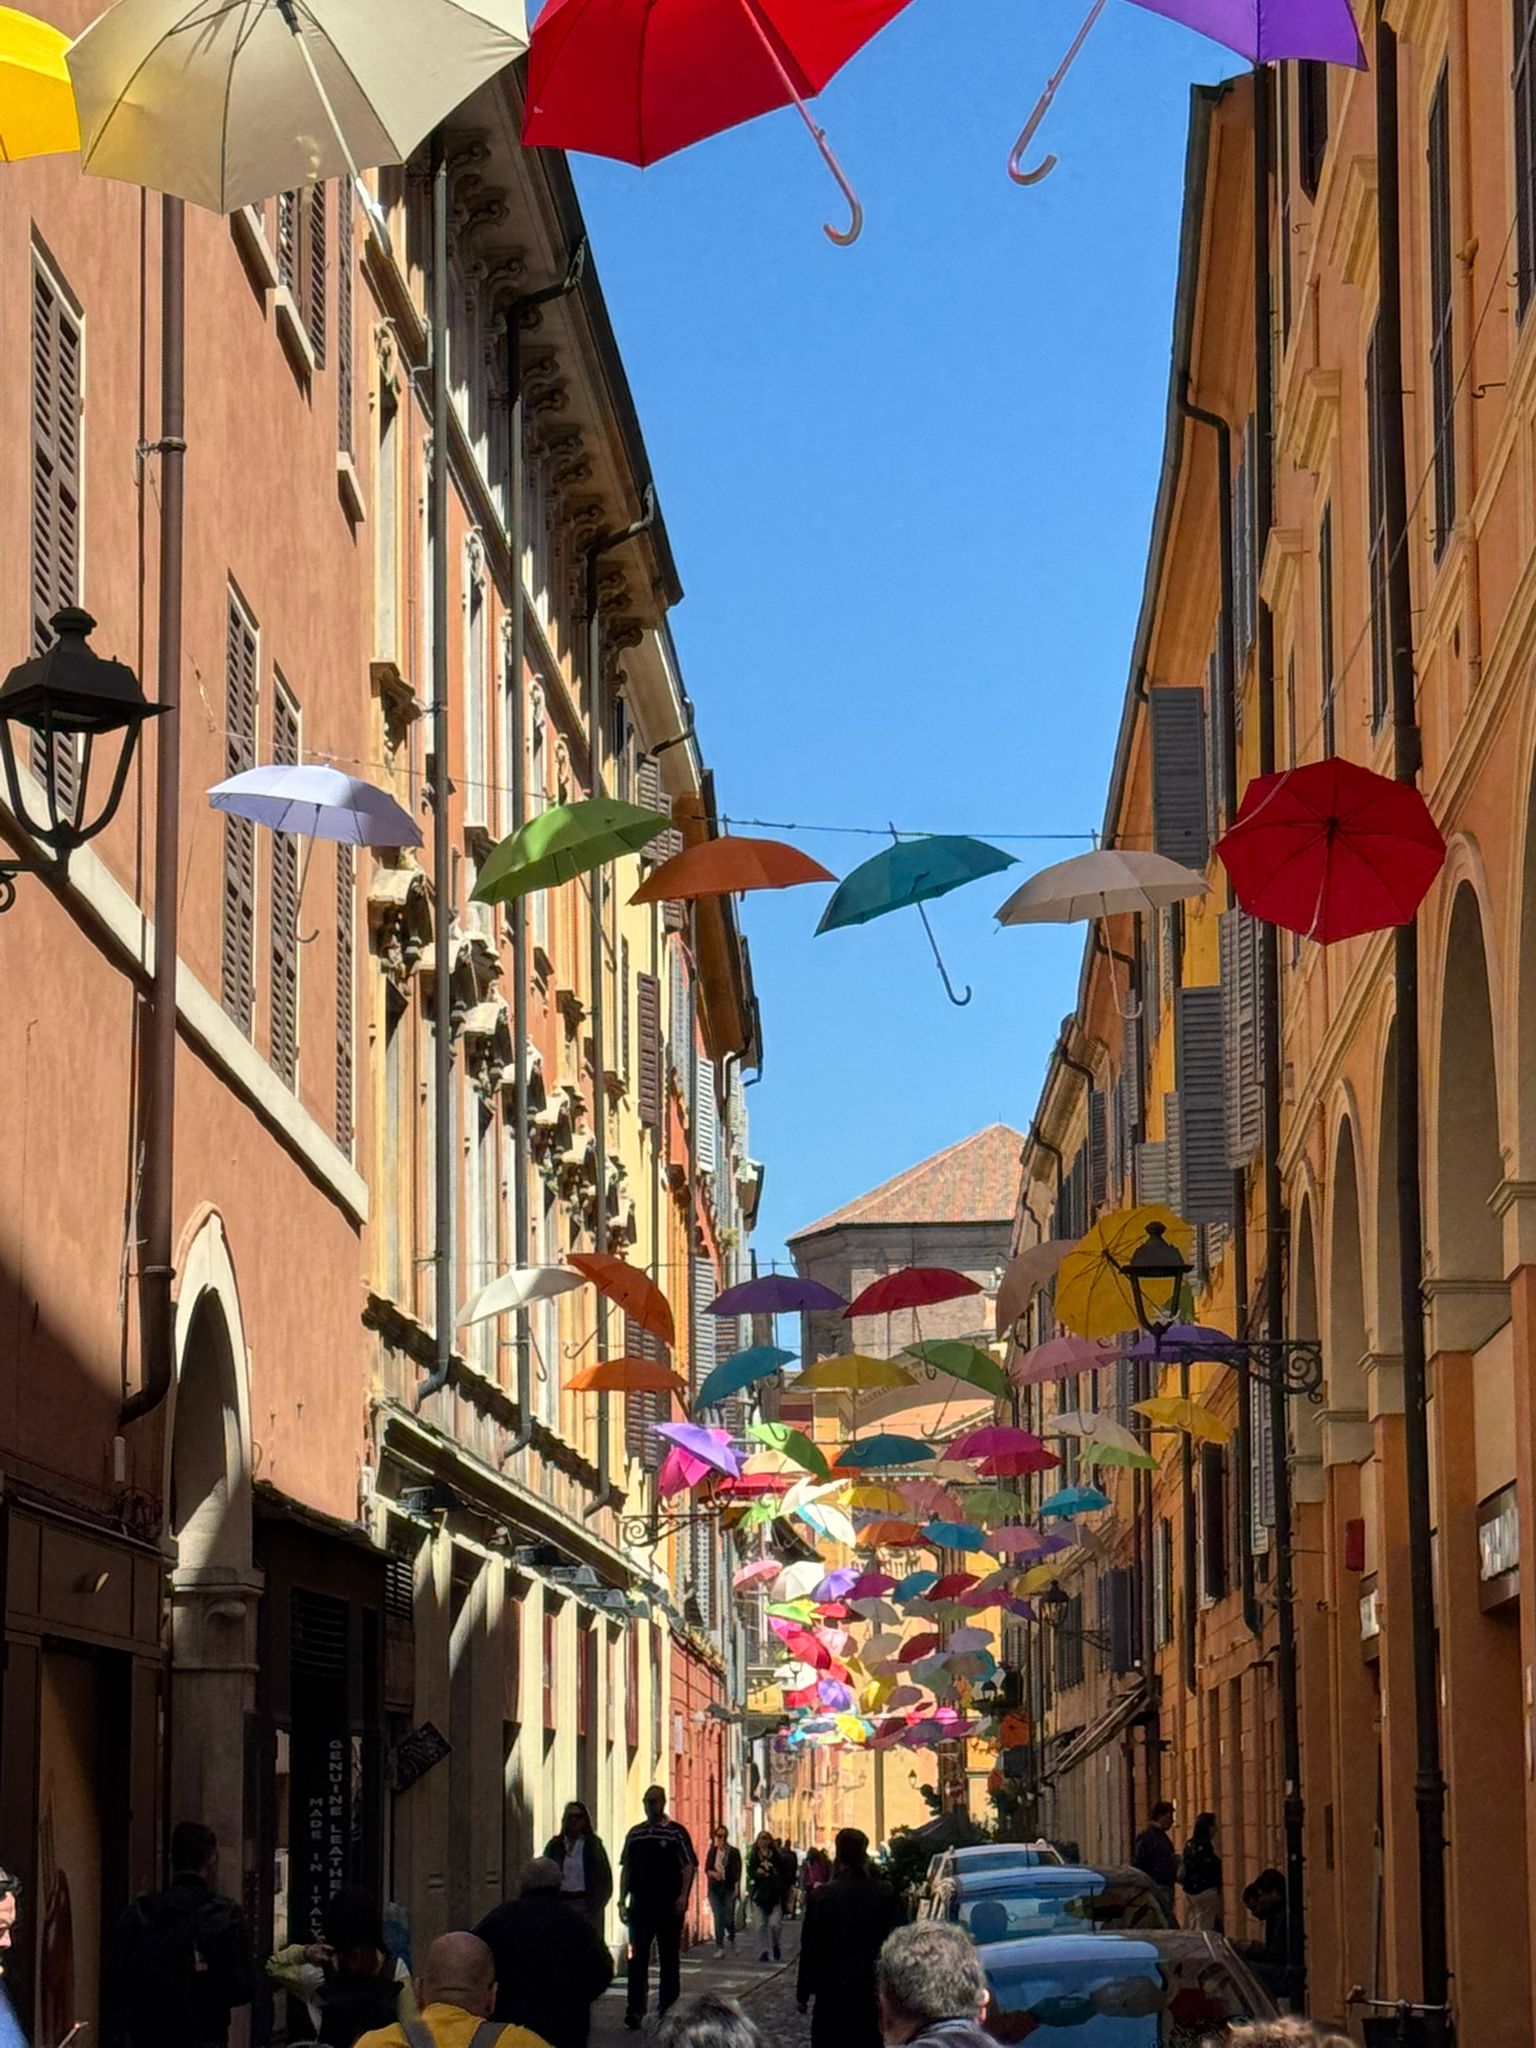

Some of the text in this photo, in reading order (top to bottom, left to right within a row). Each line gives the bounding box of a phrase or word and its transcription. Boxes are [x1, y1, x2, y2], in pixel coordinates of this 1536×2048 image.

[329, 1739, 343, 1816] GENUINE
[309, 1797, 323, 1937] MADE IN ITALY
